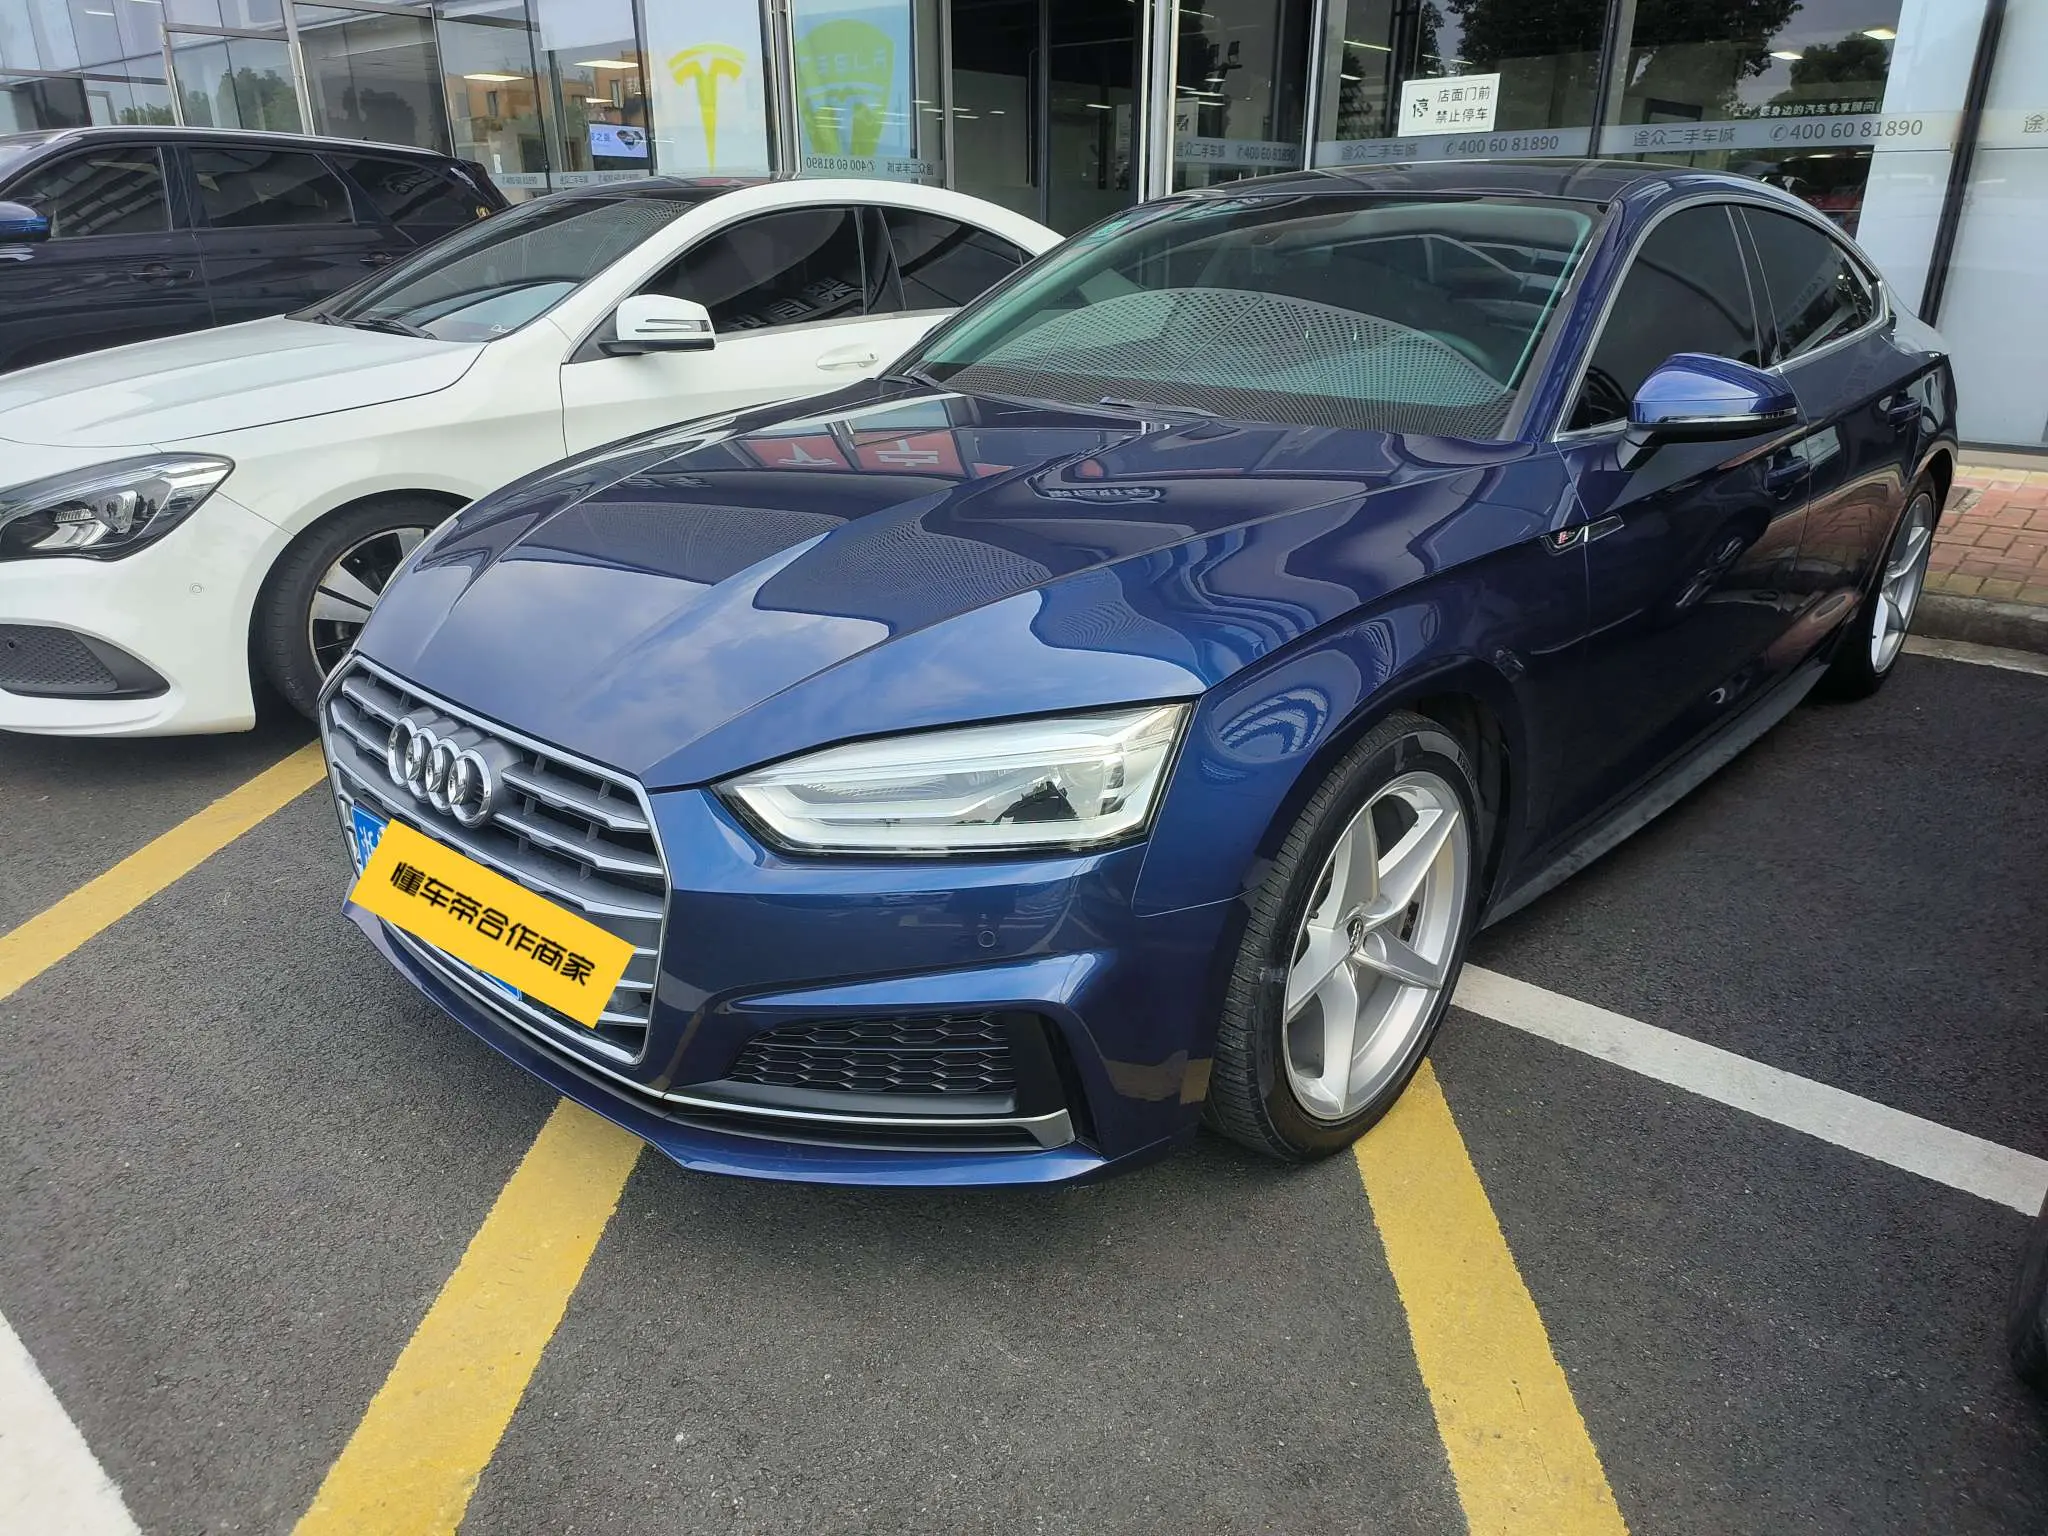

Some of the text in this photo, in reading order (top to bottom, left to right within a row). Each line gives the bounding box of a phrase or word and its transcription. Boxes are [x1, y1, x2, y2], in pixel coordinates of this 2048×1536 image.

[1437, 86, 1490, 103] 店面门前
[1435, 107, 1488, 124] 禁止停车
[1633, 119, 1923, 147] 途众二手车城 400 60 81890
[1458, 140, 1485, 154] 400
[1490, 138, 1507, 152] 60
[1512, 135, 1559, 151] 81890
